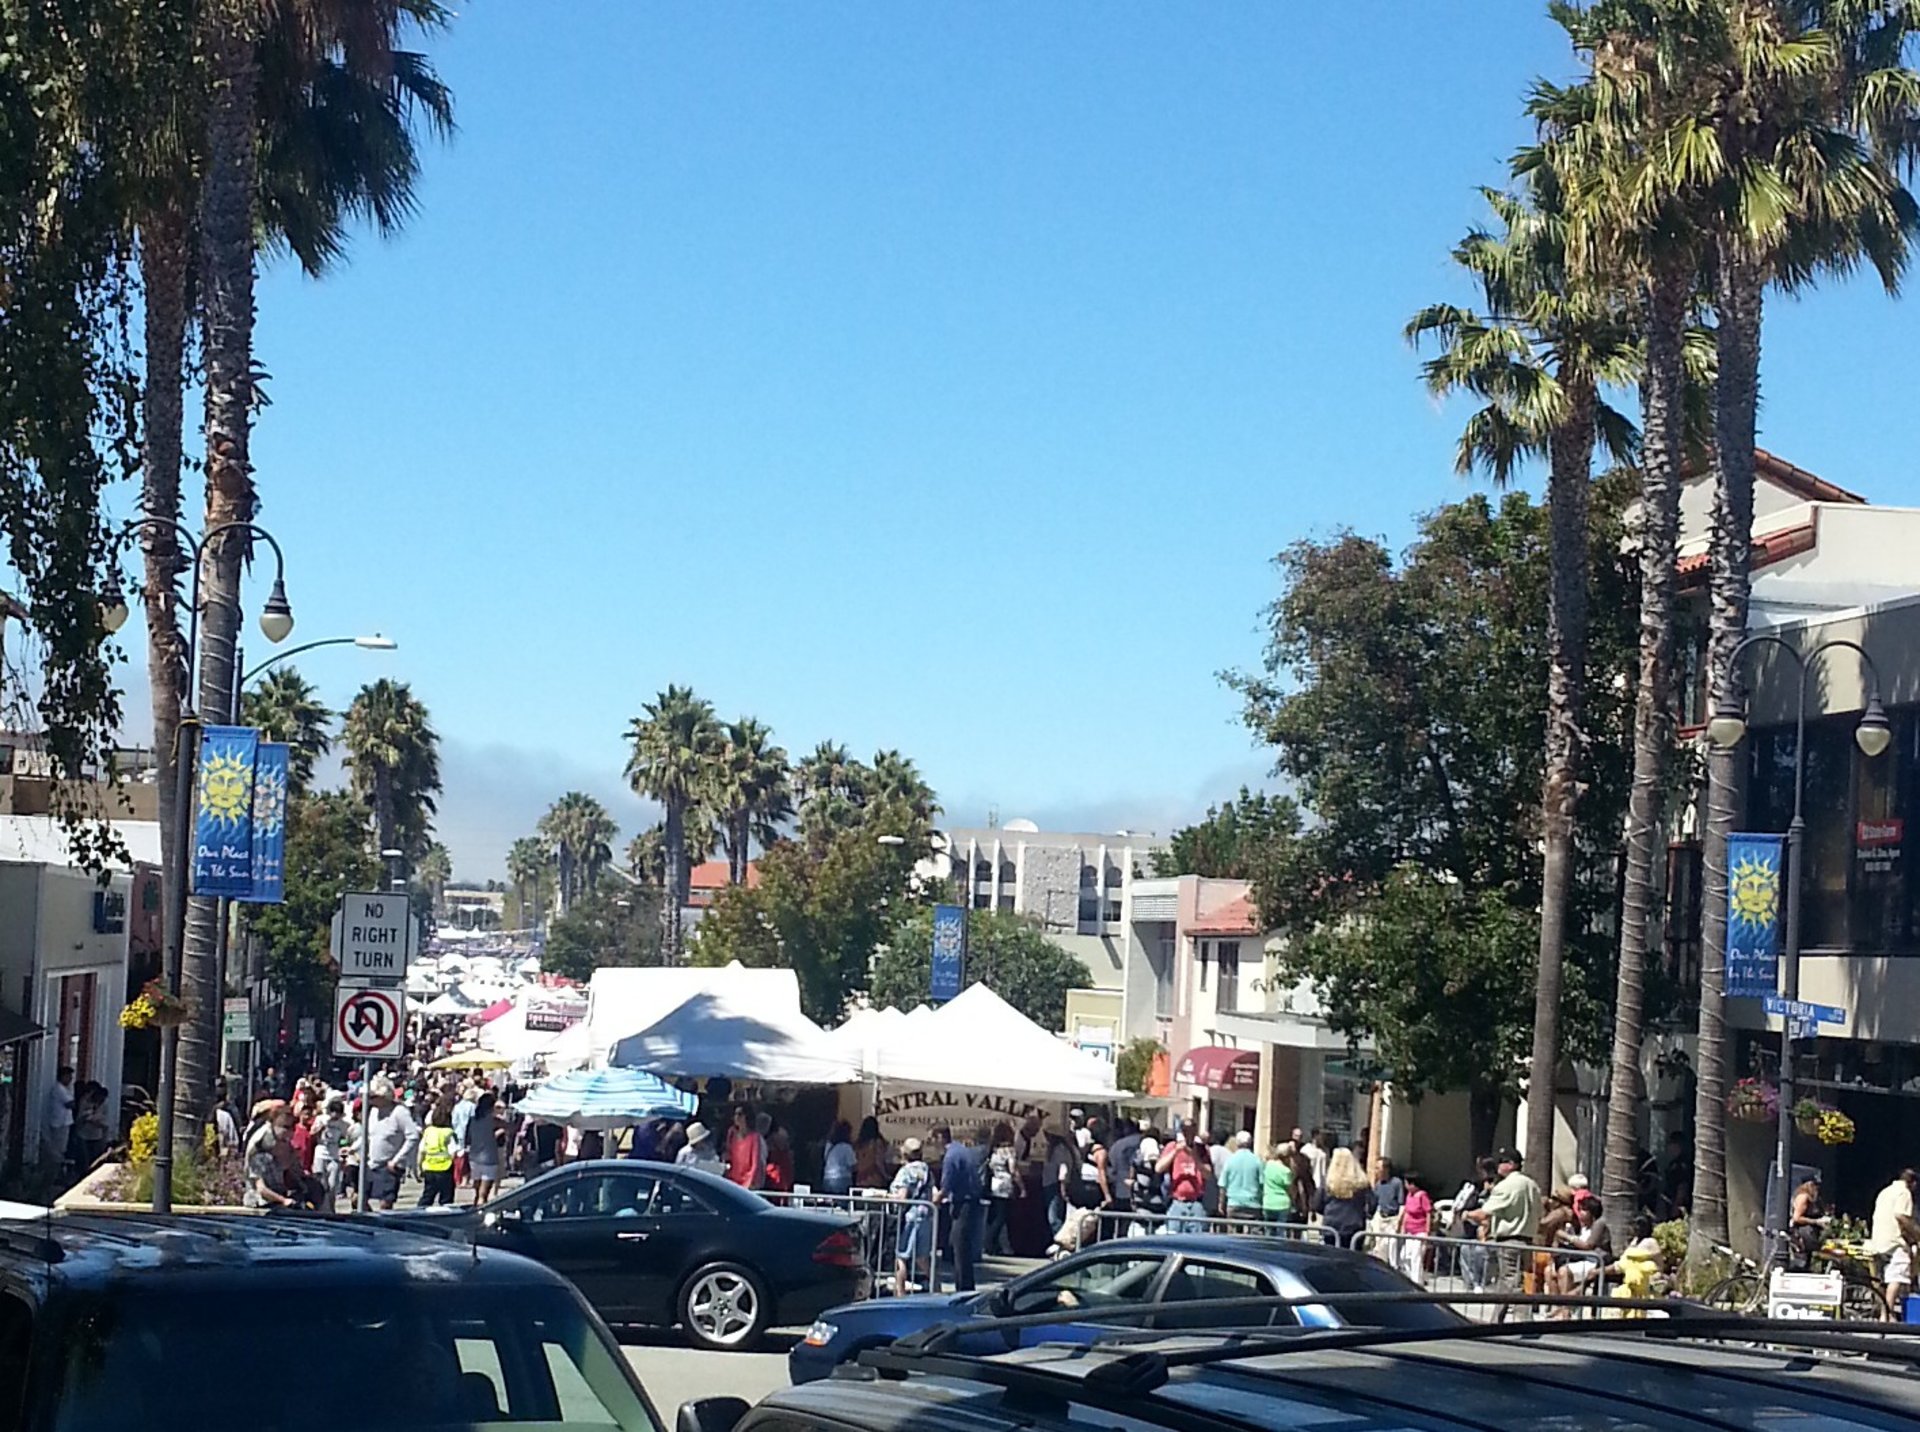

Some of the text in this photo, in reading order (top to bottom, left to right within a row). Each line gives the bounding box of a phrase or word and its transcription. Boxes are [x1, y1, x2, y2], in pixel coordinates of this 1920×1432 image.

[221, 845, 249, 859] Place
[196, 864, 250, 878] In The Sun
[364, 903, 384, 919] NO
[351, 926, 398, 944] RIGHT
[353, 950, 394, 968] TURN
[1766, 997, 1815, 1018] VICTORIA
[875, 1091, 1051, 1119] ENTRAL VALLEY
